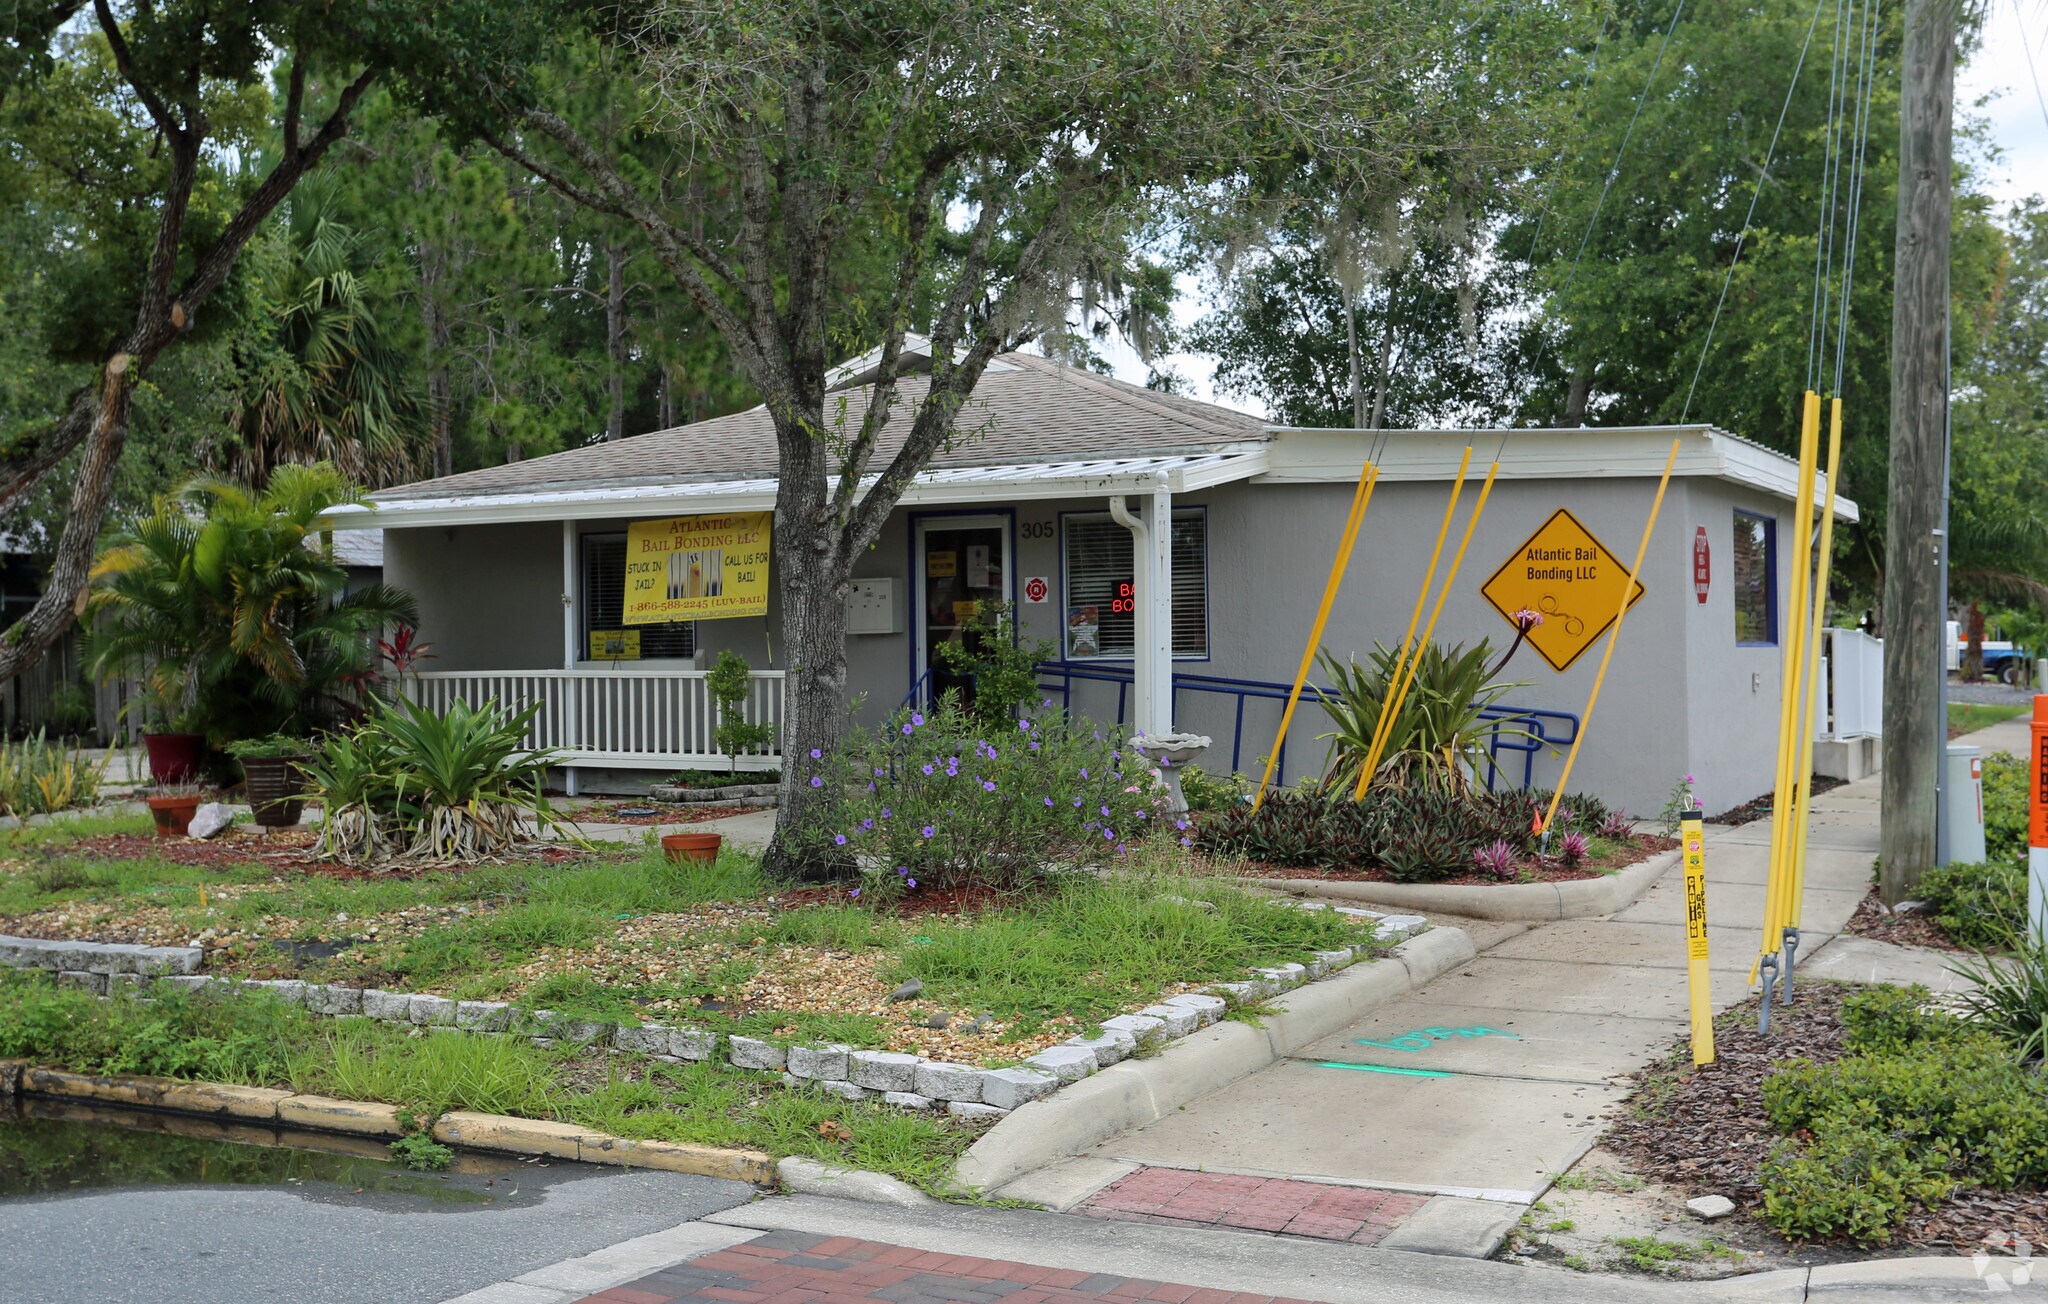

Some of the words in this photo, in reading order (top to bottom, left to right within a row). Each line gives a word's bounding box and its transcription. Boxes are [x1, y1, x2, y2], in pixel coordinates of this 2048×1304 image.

[669, 517, 732, 534] ATLANTIC
[1022, 521, 1054, 539] 305
[642, 539, 670, 553] BAIL
[674, 534, 733, 549] BONDING
[737, 532, 760, 546] LLC
[725, 554, 742, 566] CALL
[743, 553, 753, 564] US
[755, 551, 769, 564] FOR
[1526, 547, 1572, 561] Atlantic
[1575, 547, 1597, 561] Bail
[627, 562, 650, 574] STUCK
[652, 561, 662, 572] IN
[1527, 566, 1573, 583] Bonding
[1576, 566, 1597, 580] LLC
[635, 578, 655, 591] JAIL?
[737, 571, 756, 583] BAIL!
[630, 599, 708, 612] 1-866-588-2245
[711, 593, 766, 608] (LUV-BAIL)
[1687, 876, 1698, 937] CAUTION
